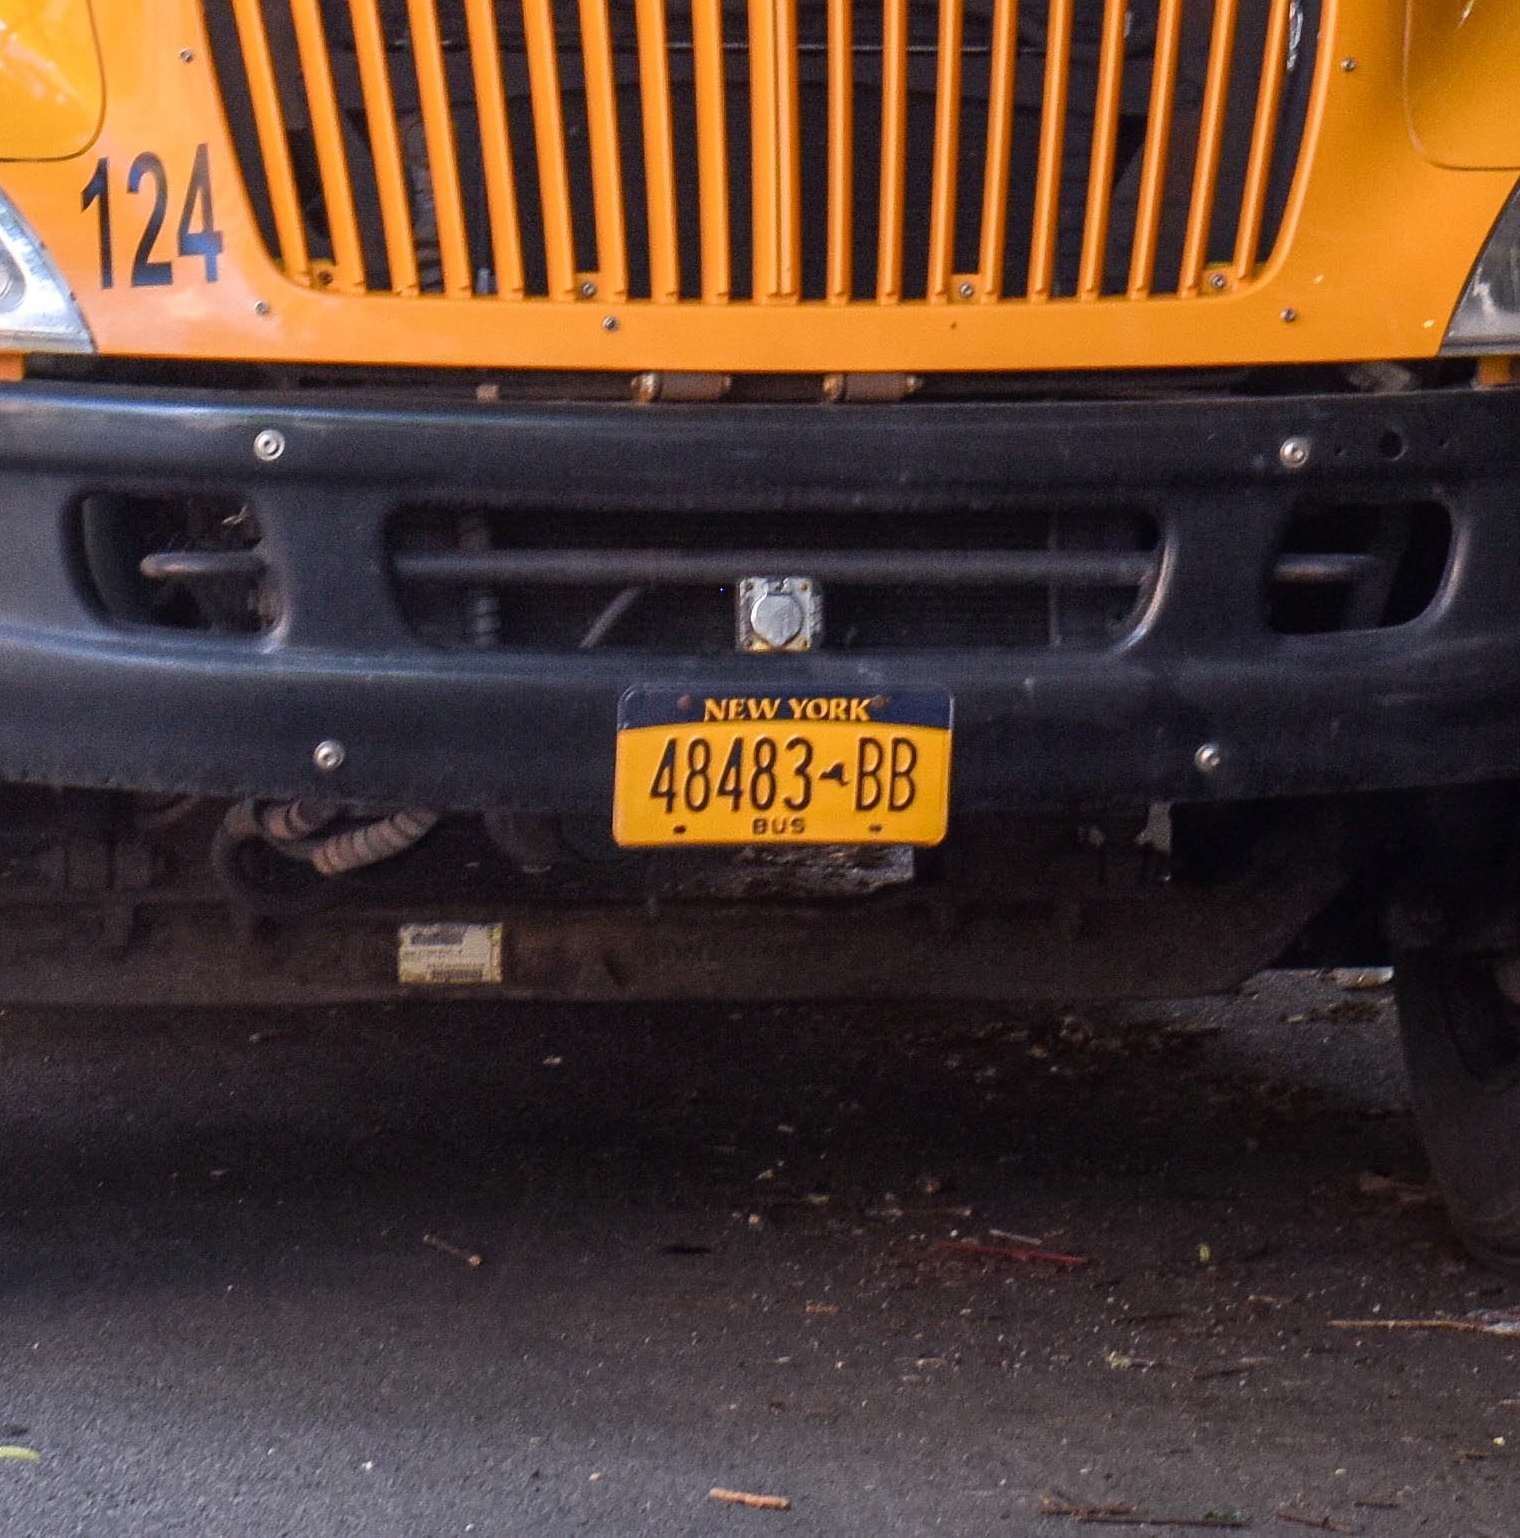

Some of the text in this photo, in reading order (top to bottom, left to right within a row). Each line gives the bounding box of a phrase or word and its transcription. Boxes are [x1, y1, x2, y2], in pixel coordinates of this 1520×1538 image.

[80, 142, 224, 290] 124
[703, 697, 872, 722] NEW YORK
[752, 818, 805, 835] BUS
